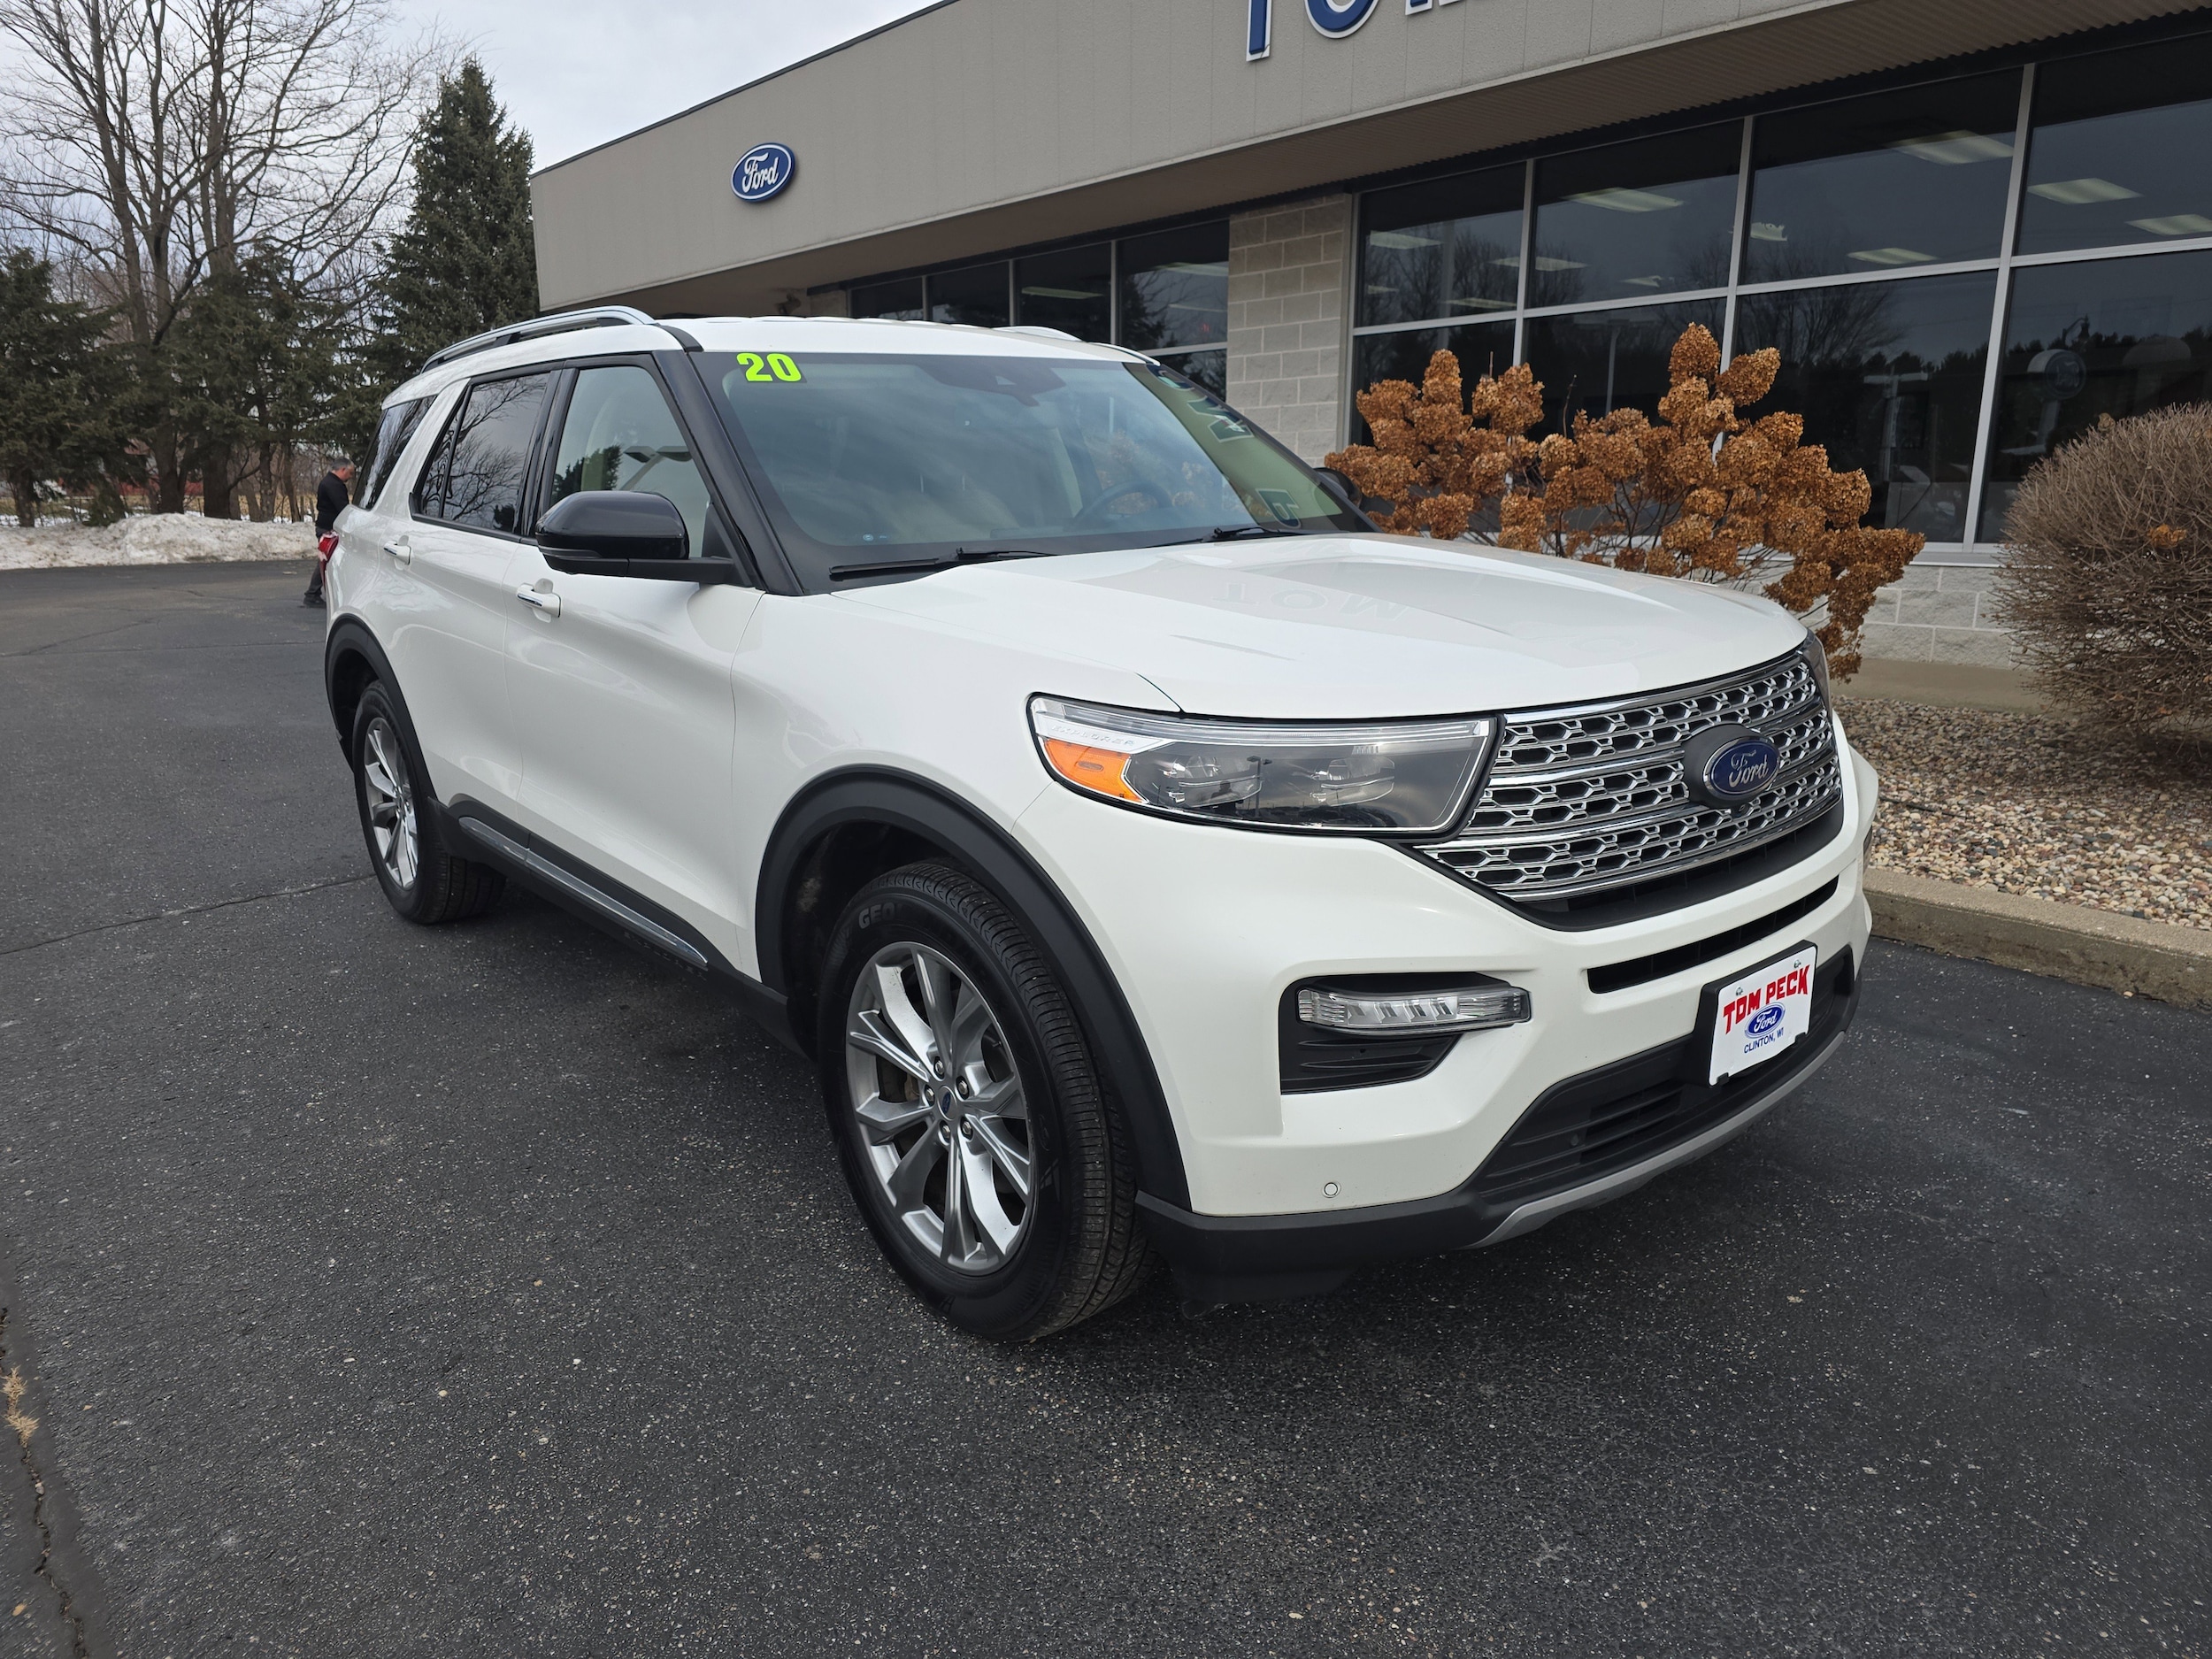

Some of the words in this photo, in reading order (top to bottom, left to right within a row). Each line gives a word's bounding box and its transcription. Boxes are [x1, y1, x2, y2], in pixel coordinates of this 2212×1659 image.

[741, 152, 780, 193] Ford
[736, 352, 802, 382] 20
[1051, 725, 1134, 745] EXPLORER
[1728, 749, 1769, 788] Ford
[1723, 987, 1762, 1034] TOM
[1765, 964, 1810, 1005] PECK
[1754, 1009, 1778, 1033] Ford
[1743, 1033, 1776, 1054] CLINTON,
[1776, 1026, 1785, 1039] WI
